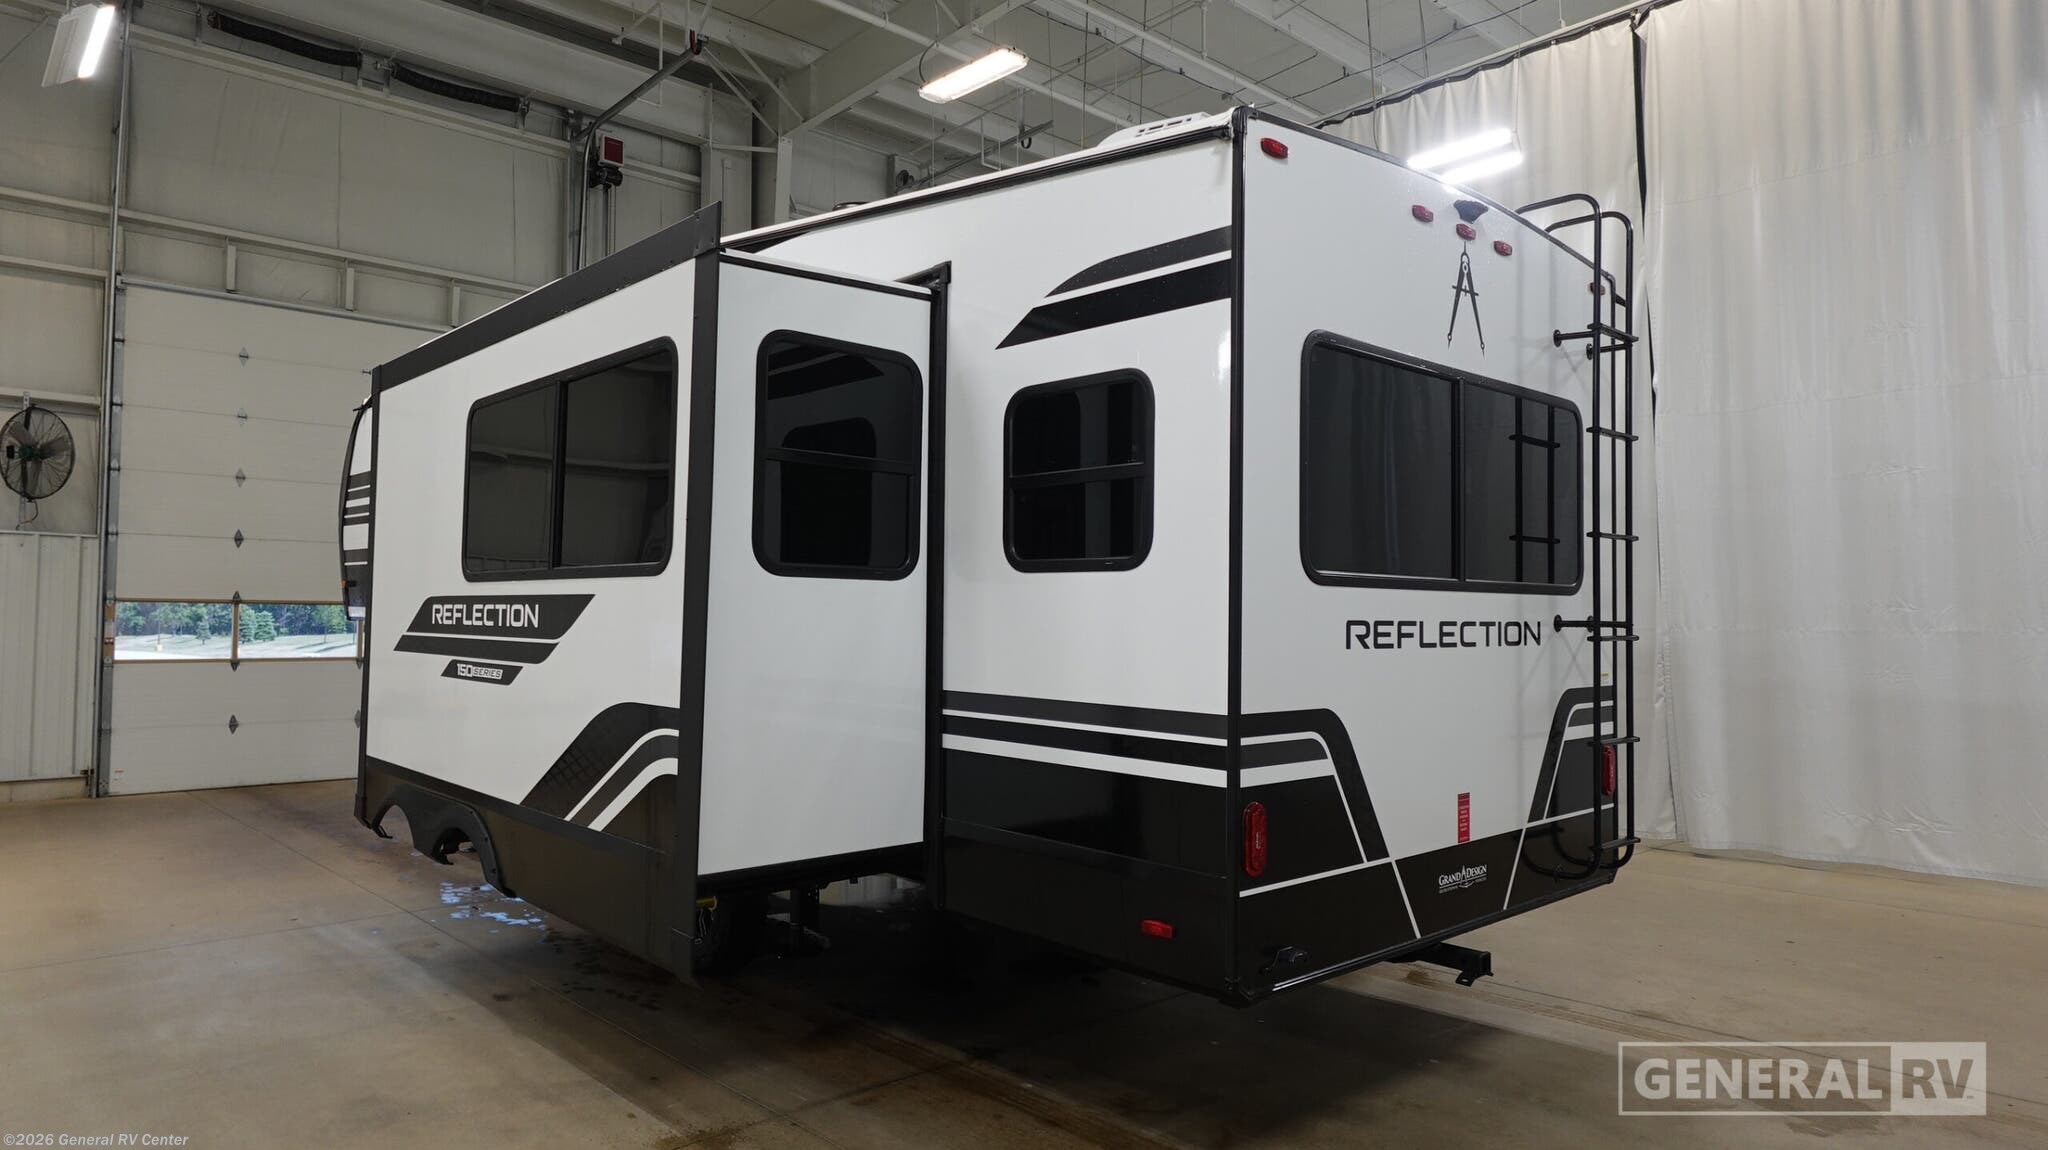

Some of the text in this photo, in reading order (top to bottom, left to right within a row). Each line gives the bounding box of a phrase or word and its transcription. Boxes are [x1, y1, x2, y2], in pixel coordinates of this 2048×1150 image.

[431, 604, 539, 628] REFLECTION
[1345, 619, 1541, 650] REFLECTION
[457, 663, 503, 679] 150 SERIES
[1439, 872, 1461, 885] GRAND
[1466, 864, 1487, 878] DESIGN
